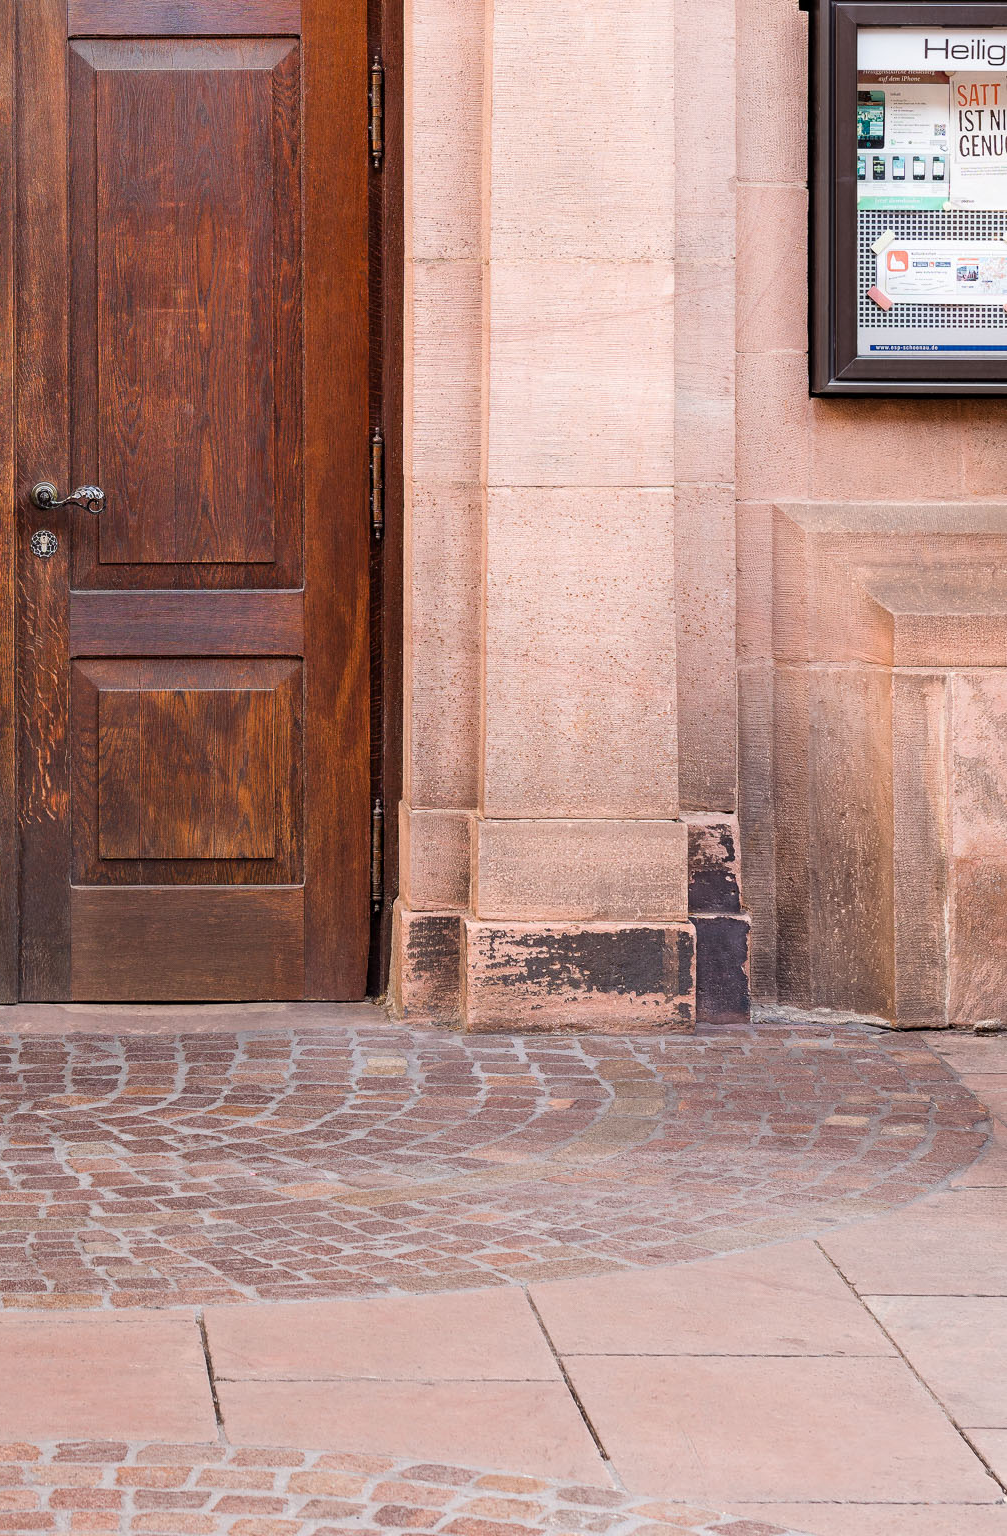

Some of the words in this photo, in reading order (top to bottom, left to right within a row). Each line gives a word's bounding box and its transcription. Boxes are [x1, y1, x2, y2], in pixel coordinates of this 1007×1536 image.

[924, 39, 1006, 66] Heilig
[957, 83, 1001, 106] SATT
[958, 109, 984, 131] IST
[990, 109, 1006, 131] NI
[959, 135, 1007, 157] GENU
